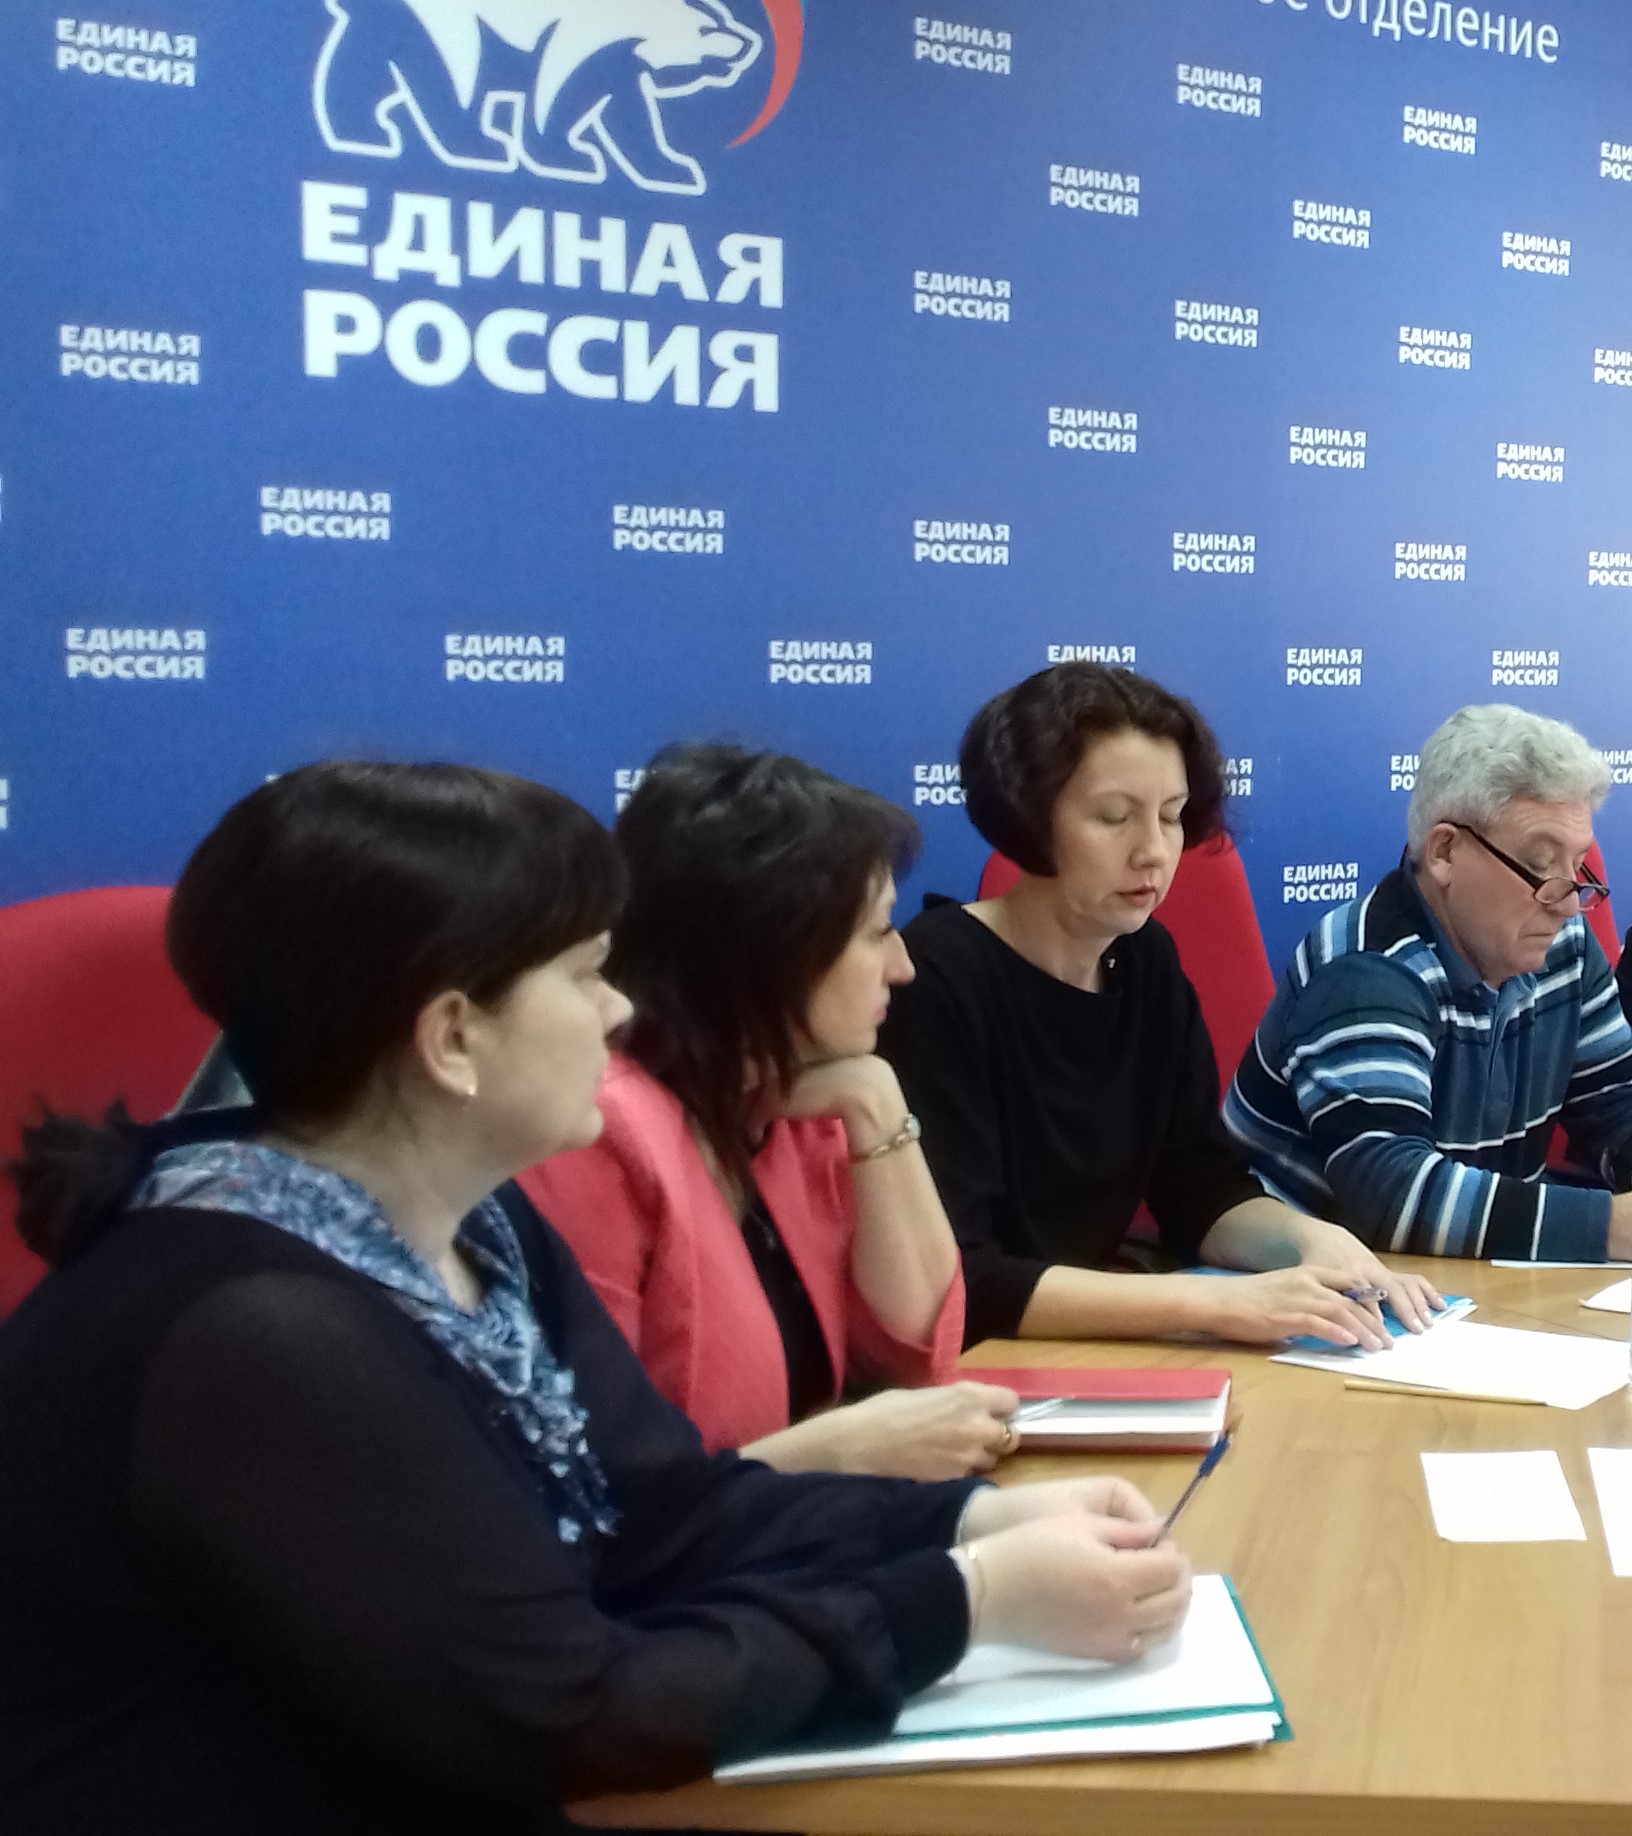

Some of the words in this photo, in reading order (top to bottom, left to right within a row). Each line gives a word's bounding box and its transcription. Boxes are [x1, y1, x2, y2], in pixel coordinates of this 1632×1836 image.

[55, 17, 197, 59] ЕДИНАЯ
[914, 17, 1012, 51] ЕДИНАЯ
[55, 43, 195, 87] РОССИЯ
[914, 39, 1010, 75] РОССИЯ
[1177, 64, 1262, 95] ЕДИНАЯ
[1177, 85, 1261, 117] РОССИЯ
[1403, 105, 1477, 134] ЕДИНАЯ
[1403, 124, 1475, 155] РОССИЯ
[1049, 164, 1140, 194] ЕДИНАЯ
[1049, 186, 1139, 217] РОССИЯ
[1293, 199, 1371, 227] ЕДИНАЯ
[301, 181, 783, 309] ЕДИНАЯ
[1293, 220, 1369, 249] РОССИЯ
[1502, 231, 1571, 256] ЕДИНАЯ
[1502, 250, 1569, 276] РОССИЯ
[914, 270, 1011, 298] ЕДИНАЯ
[914, 293, 1010, 322] РОССИЯ
[1175, 300, 1258, 326] ЕДИНАЯ
[59, 324, 201, 357] ЕДИНАЯ
[1175, 320, 1257, 347] РОССИЯ
[1399, 326, 1471, 349] ЕДИНАЯ
[303, 290, 779, 413] РОССИЯ
[1399, 345, 1470, 370] РОССИЯ
[59, 350, 200, 385] РОССИЯ
[1048, 407, 1138, 430] ЕДИНАЯ
[1048, 428, 1137, 453] РОССИЯ
[1290, 426, 1366, 448] ЕДИНАЯ
[1290, 446, 1365, 468] РОССИЯ
[1497, 443, 1564, 462] ЕДИНАЯ
[1497, 461, 1563, 482] РОССИЯ
[260, 485, 391, 514] ЕДИНАЯ
[260, 511, 390, 540] РОССИЯ
[612, 504, 725, 529] ЕДИНАЯ
[613, 528, 723, 554] РОССИЯ
[913, 520, 1010, 542] ЕДИНАЯ
[1173, 532, 1255, 552] ЕДИНАЯ
[914, 541, 1009, 565] РОССИЯ
[1173, 552, 1254, 574] РОССИЯ
[1395, 543, 1466, 561] ЕДИНАЯ
[1395, 562, 1465, 581] РОССИЯ
[64, 626, 207, 653] ЕДИНАЯ
[444, 632, 565, 658] ЕДИНАЯ
[769, 640, 872, 662] ЕДИНАЯ
[65, 653, 206, 680] РОССИЯ
[1047, 645, 1136, 664] ЕДИНАЯ
[1287, 648, 1362, 667] ЕДИНАЯ
[1492, 650, 1559, 668] ЕДИНАЯ
[445, 658, 564, 683] РОССИЯ
[769, 663, 871, 685] РОССИЯ
[1287, 668, 1361, 686] РОССИЯ
[1492, 669, 1558, 686] РОССИЯ
[913, 764, 962, 785] ЕДИ
[913, 785, 968, 806] РОС
[1283, 863, 1359, 884] ЕДИНАЯ
[1283, 882, 1357, 904] РОССИЯ
